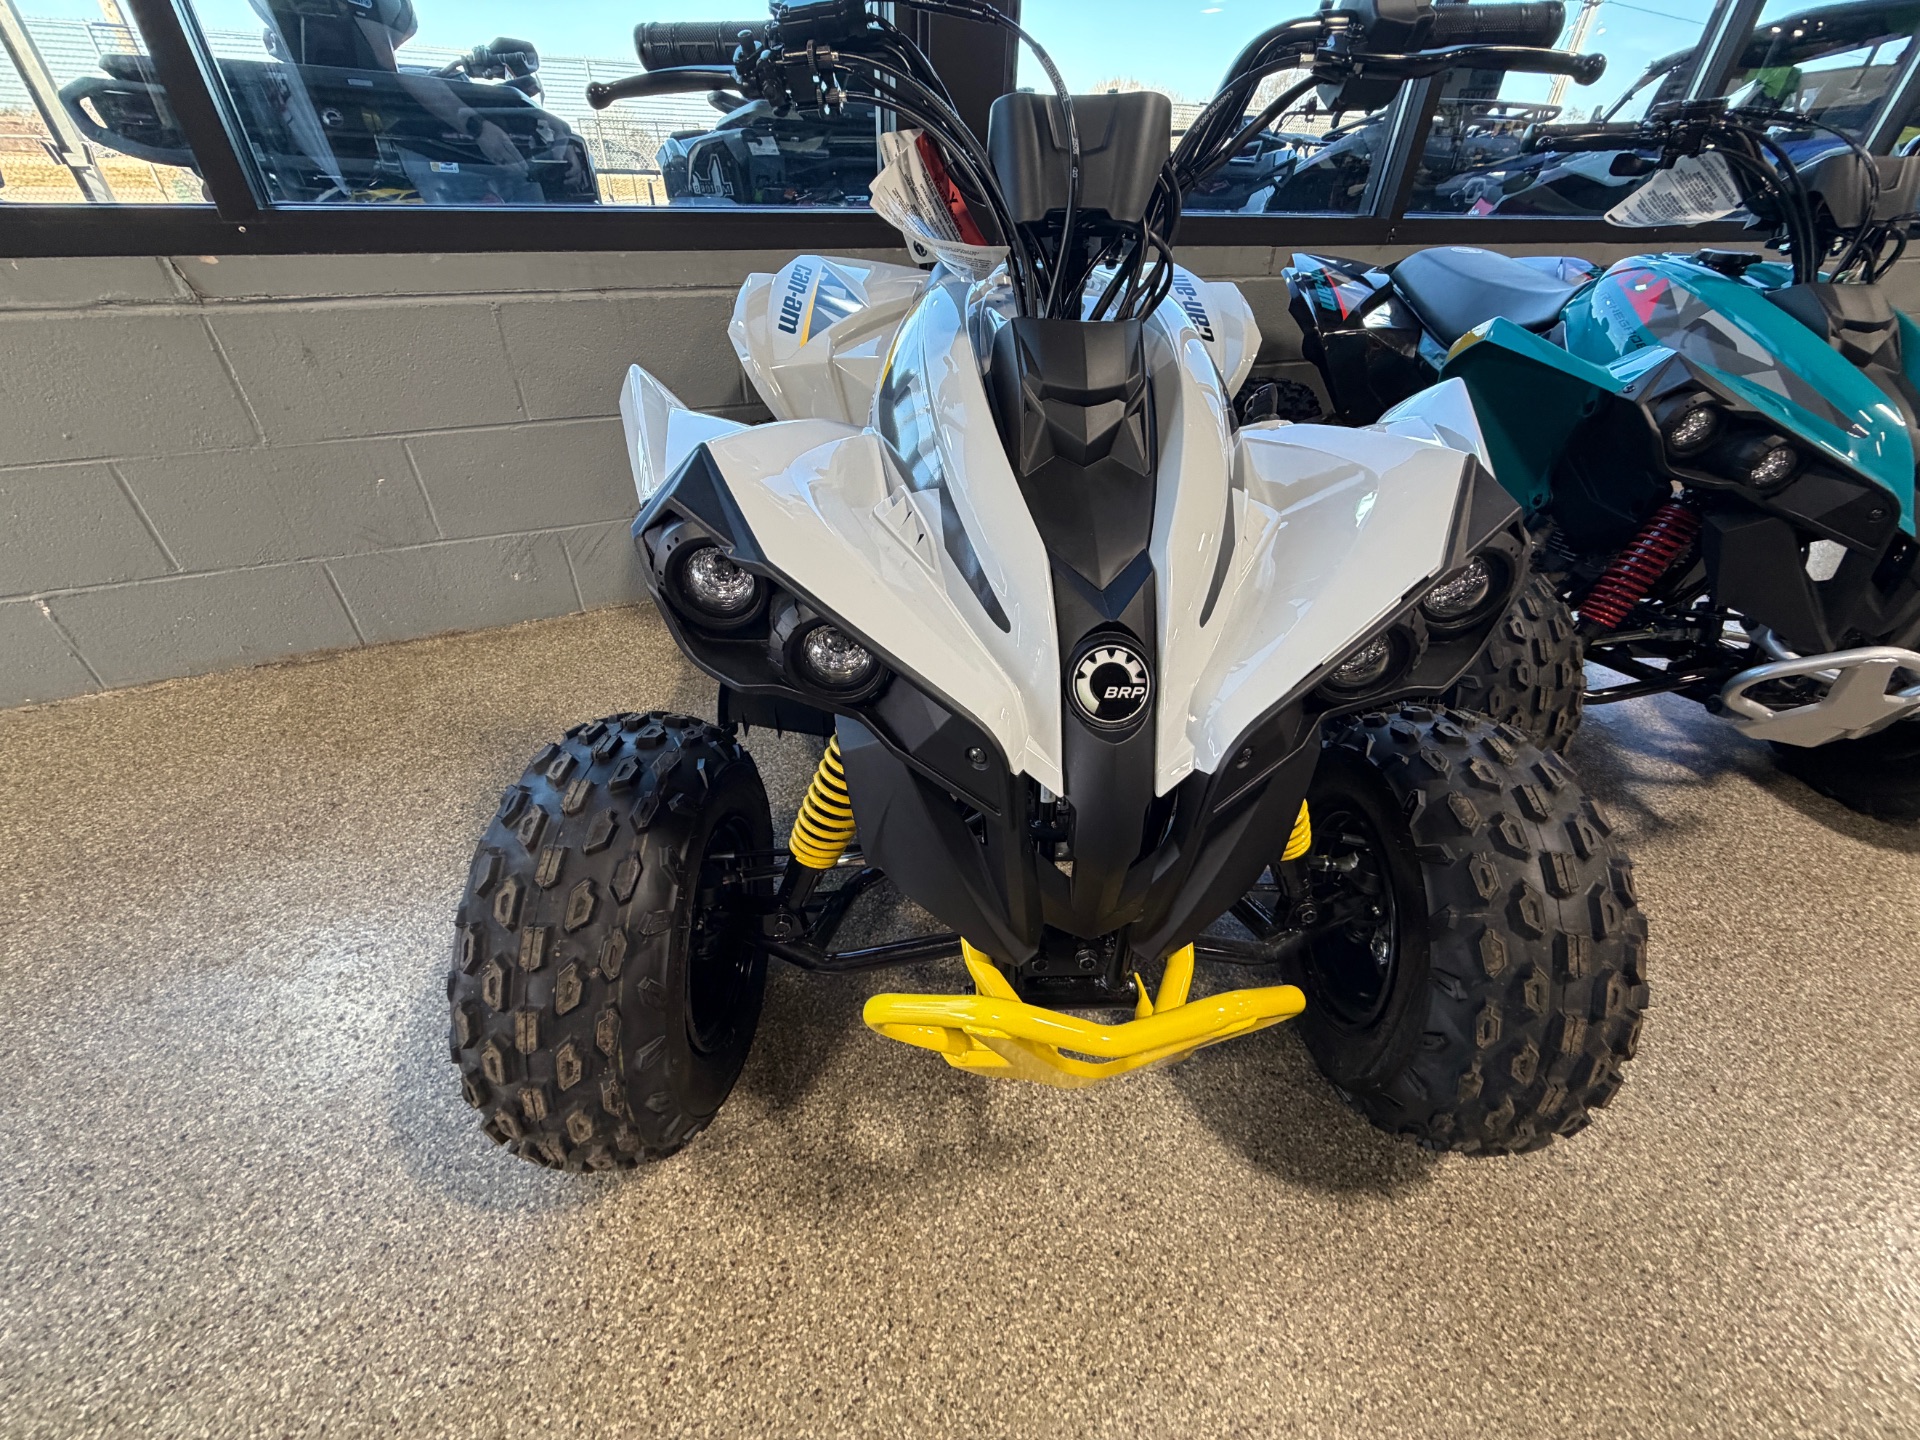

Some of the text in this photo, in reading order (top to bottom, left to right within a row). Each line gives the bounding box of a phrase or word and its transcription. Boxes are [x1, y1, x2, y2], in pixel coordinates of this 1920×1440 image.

[777, 264, 812, 334] can-am
[1173, 275, 1214, 342] can-am
[1104, 686, 1146, 699] BRP
